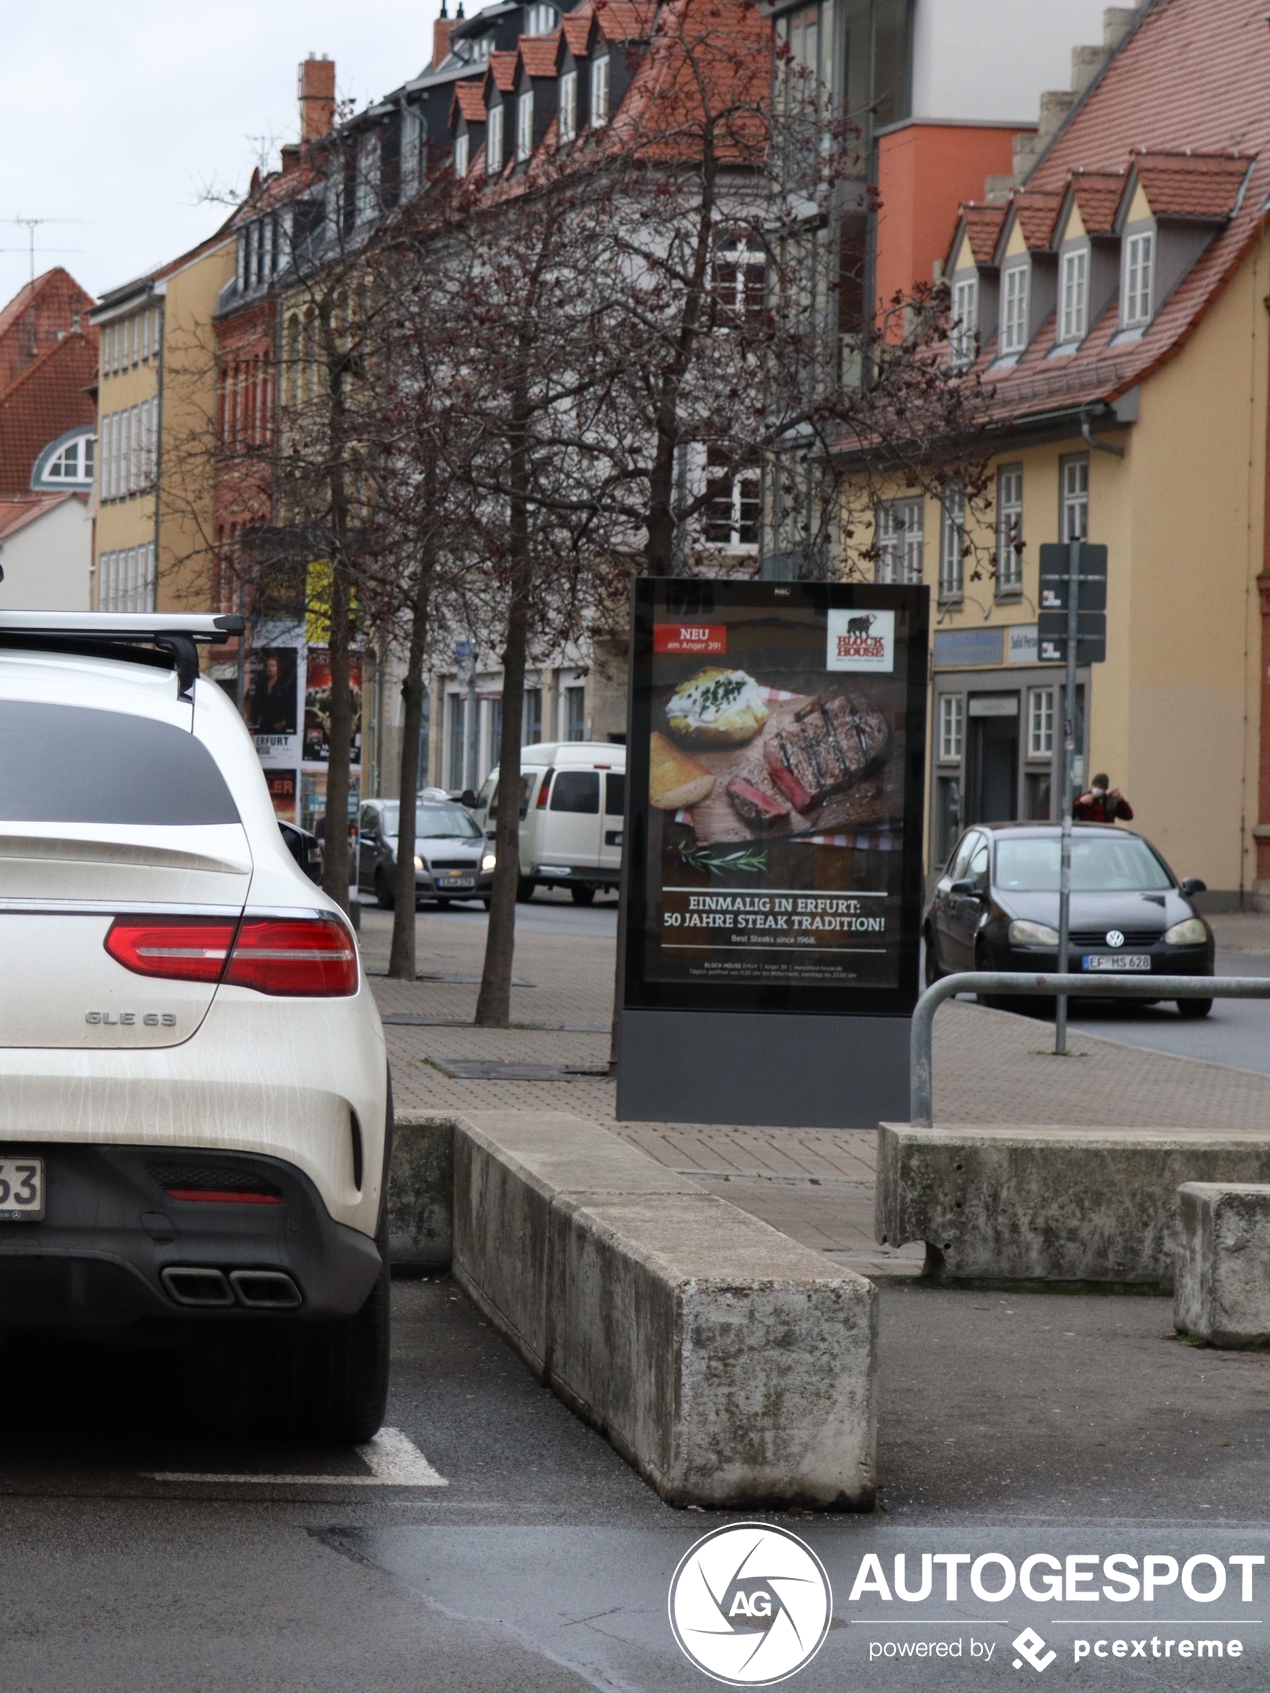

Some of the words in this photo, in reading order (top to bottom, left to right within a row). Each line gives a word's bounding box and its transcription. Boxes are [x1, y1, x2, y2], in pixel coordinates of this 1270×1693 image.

[680, 628, 709, 640] NEU
[682, 642, 706, 651] Anger
[837, 636, 884, 647] BLOCK
[837, 647, 884, 657] HOUSE
[256, 736, 289, 746] ERFURT
[689, 896, 770, 911] EINMALIG
[774, 898, 793, 912] IN
[796, 899, 860, 914] ERFURT:
[664, 913, 681, 926] 50
[683, 913, 734, 928] JAHRE
[737, 914, 788, 929] STEAK
[791, 915, 885, 931] TRADITION!
[731, 934, 748, 943] Best
[750, 934, 774, 943] Steaks
[85, 1011, 135, 1025] GLE
[143, 1013, 177, 1026] 63
